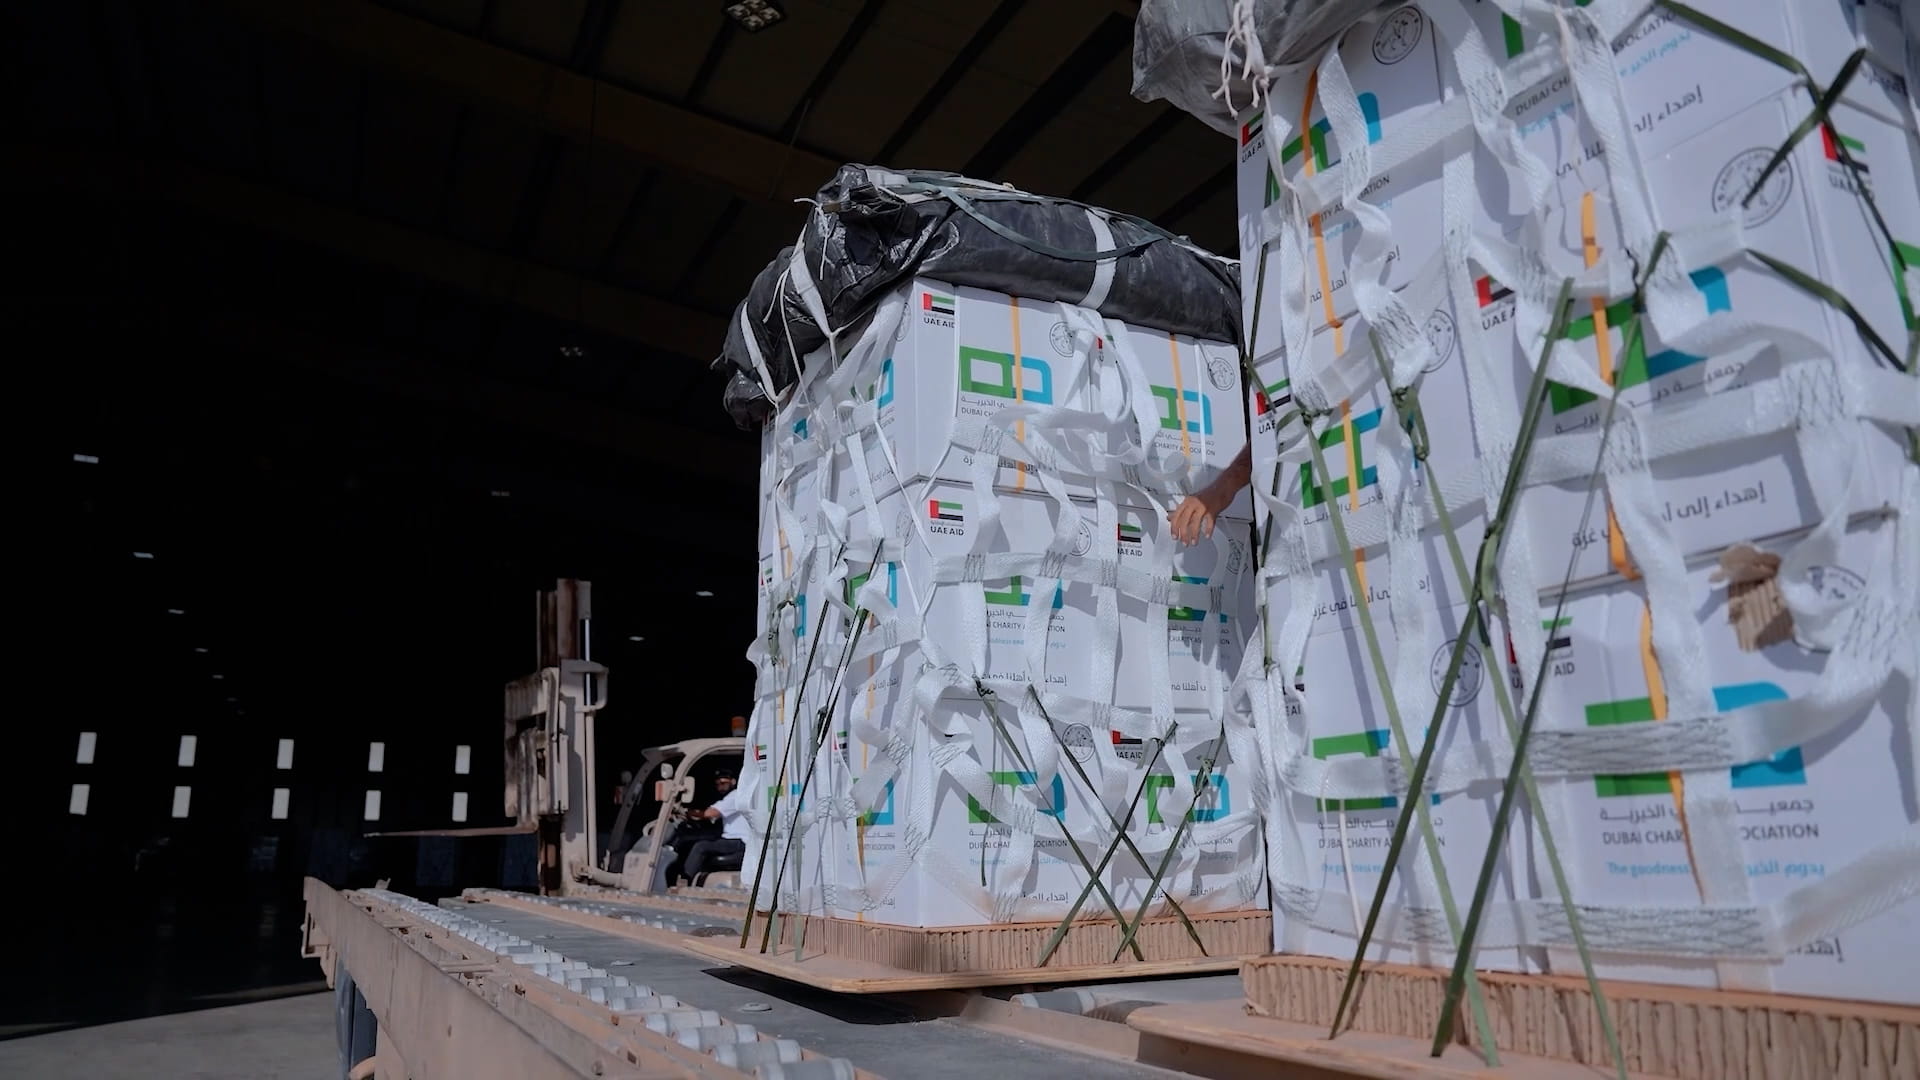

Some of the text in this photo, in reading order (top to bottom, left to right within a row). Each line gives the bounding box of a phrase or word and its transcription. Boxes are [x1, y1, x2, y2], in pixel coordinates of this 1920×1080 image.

[1515, 87, 1550, 116] DUBAI
[1658, 84, 1704, 121] إهداء
[923, 317, 941, 326] UAE
[1482, 309, 1508, 331] UAE
[961, 407, 983, 417] DUBAI
[1258, 419, 1276, 434] UAE
[1714, 480, 1767, 511] إهداء
[1677, 496, 1710, 519] إلى
[930, 525, 965, 536] UAE AID
[1130, 548, 1143, 557] AID
[1329, 596, 1348, 616] في
[993, 621, 1021, 631] CHARITY
[1554, 660, 1576, 677] AID
[1599, 803, 1666, 825] الخيرية
[1602, 822, 1819, 845] DUBAI CHAR OCIATION
